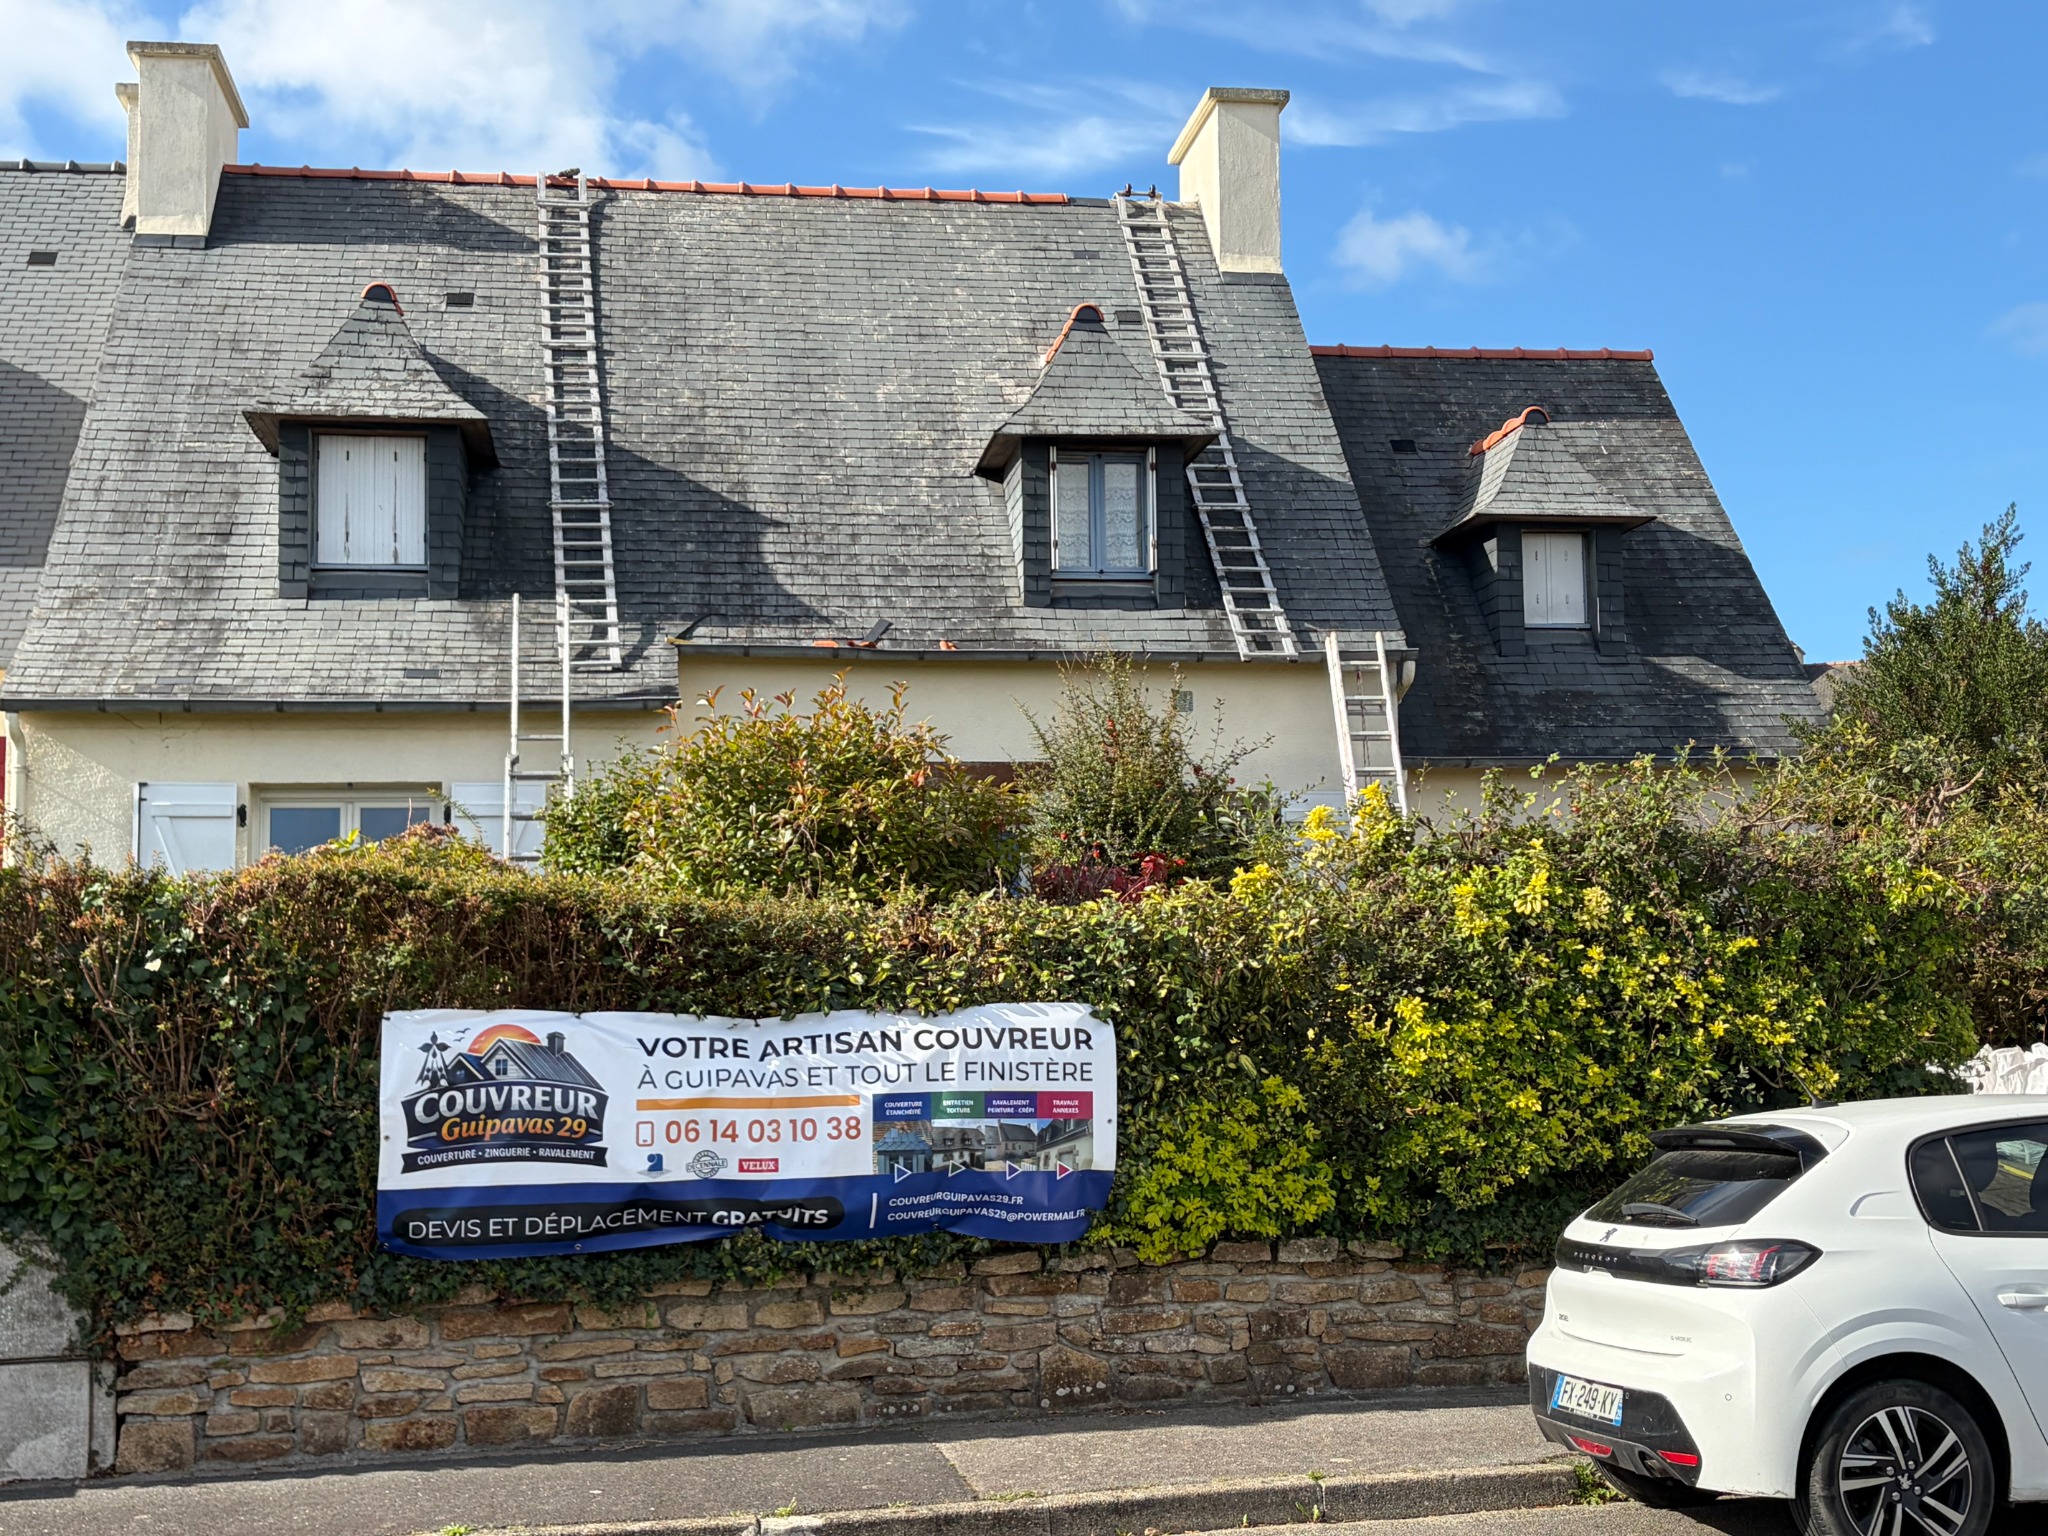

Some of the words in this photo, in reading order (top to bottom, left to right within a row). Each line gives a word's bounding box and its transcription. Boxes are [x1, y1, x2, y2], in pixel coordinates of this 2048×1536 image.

[635, 1036, 750, 1059] VOTRE
[758, 1030, 902, 1062] ARTISAN
[913, 1027, 1094, 1051] COUVREUR
[637, 1064, 658, 1089] À
[664, 1067, 799, 1090] GUIPAVAS
[807, 1066, 838, 1087] ET
[844, 1062, 918, 1085] TOUT
[925, 1061, 956, 1082] LE
[964, 1057, 1094, 1082] FINISTÈRE
[414, 1085, 599, 1125] COUVREUR
[441, 1114, 555, 1142] Guipavas
[556, 1116, 587, 1139] 29
[665, 1119, 700, 1144] 06
[709, 1119, 739, 1143] 14
[748, 1119, 781, 1143] 03
[788, 1118, 818, 1142] 10
[826, 1115, 862, 1141] 38
[417, 1149, 477, 1166] COUVERTURE
[484, 1147, 531, 1158] ZINGUERIE
[538, 1148, 596, 1160] RAVALEMENT
[741, 1161, 776, 1171] VELUX
[888, 1191, 1024, 1207] COUVREURGUIPAVAS29.FR
[409, 1218, 482, 1240] DEVIS
[488, 1217, 519, 1237] ET
[524, 1207, 708, 1236] DÉPLACEMENT
[711, 1207, 829, 1226] GRATUITS
[887, 1207, 1086, 1222] COUVREURGUIPAVAS29@POWERMAIL.FR
[1560, 1380, 1618, 1415] FX-249-KY
